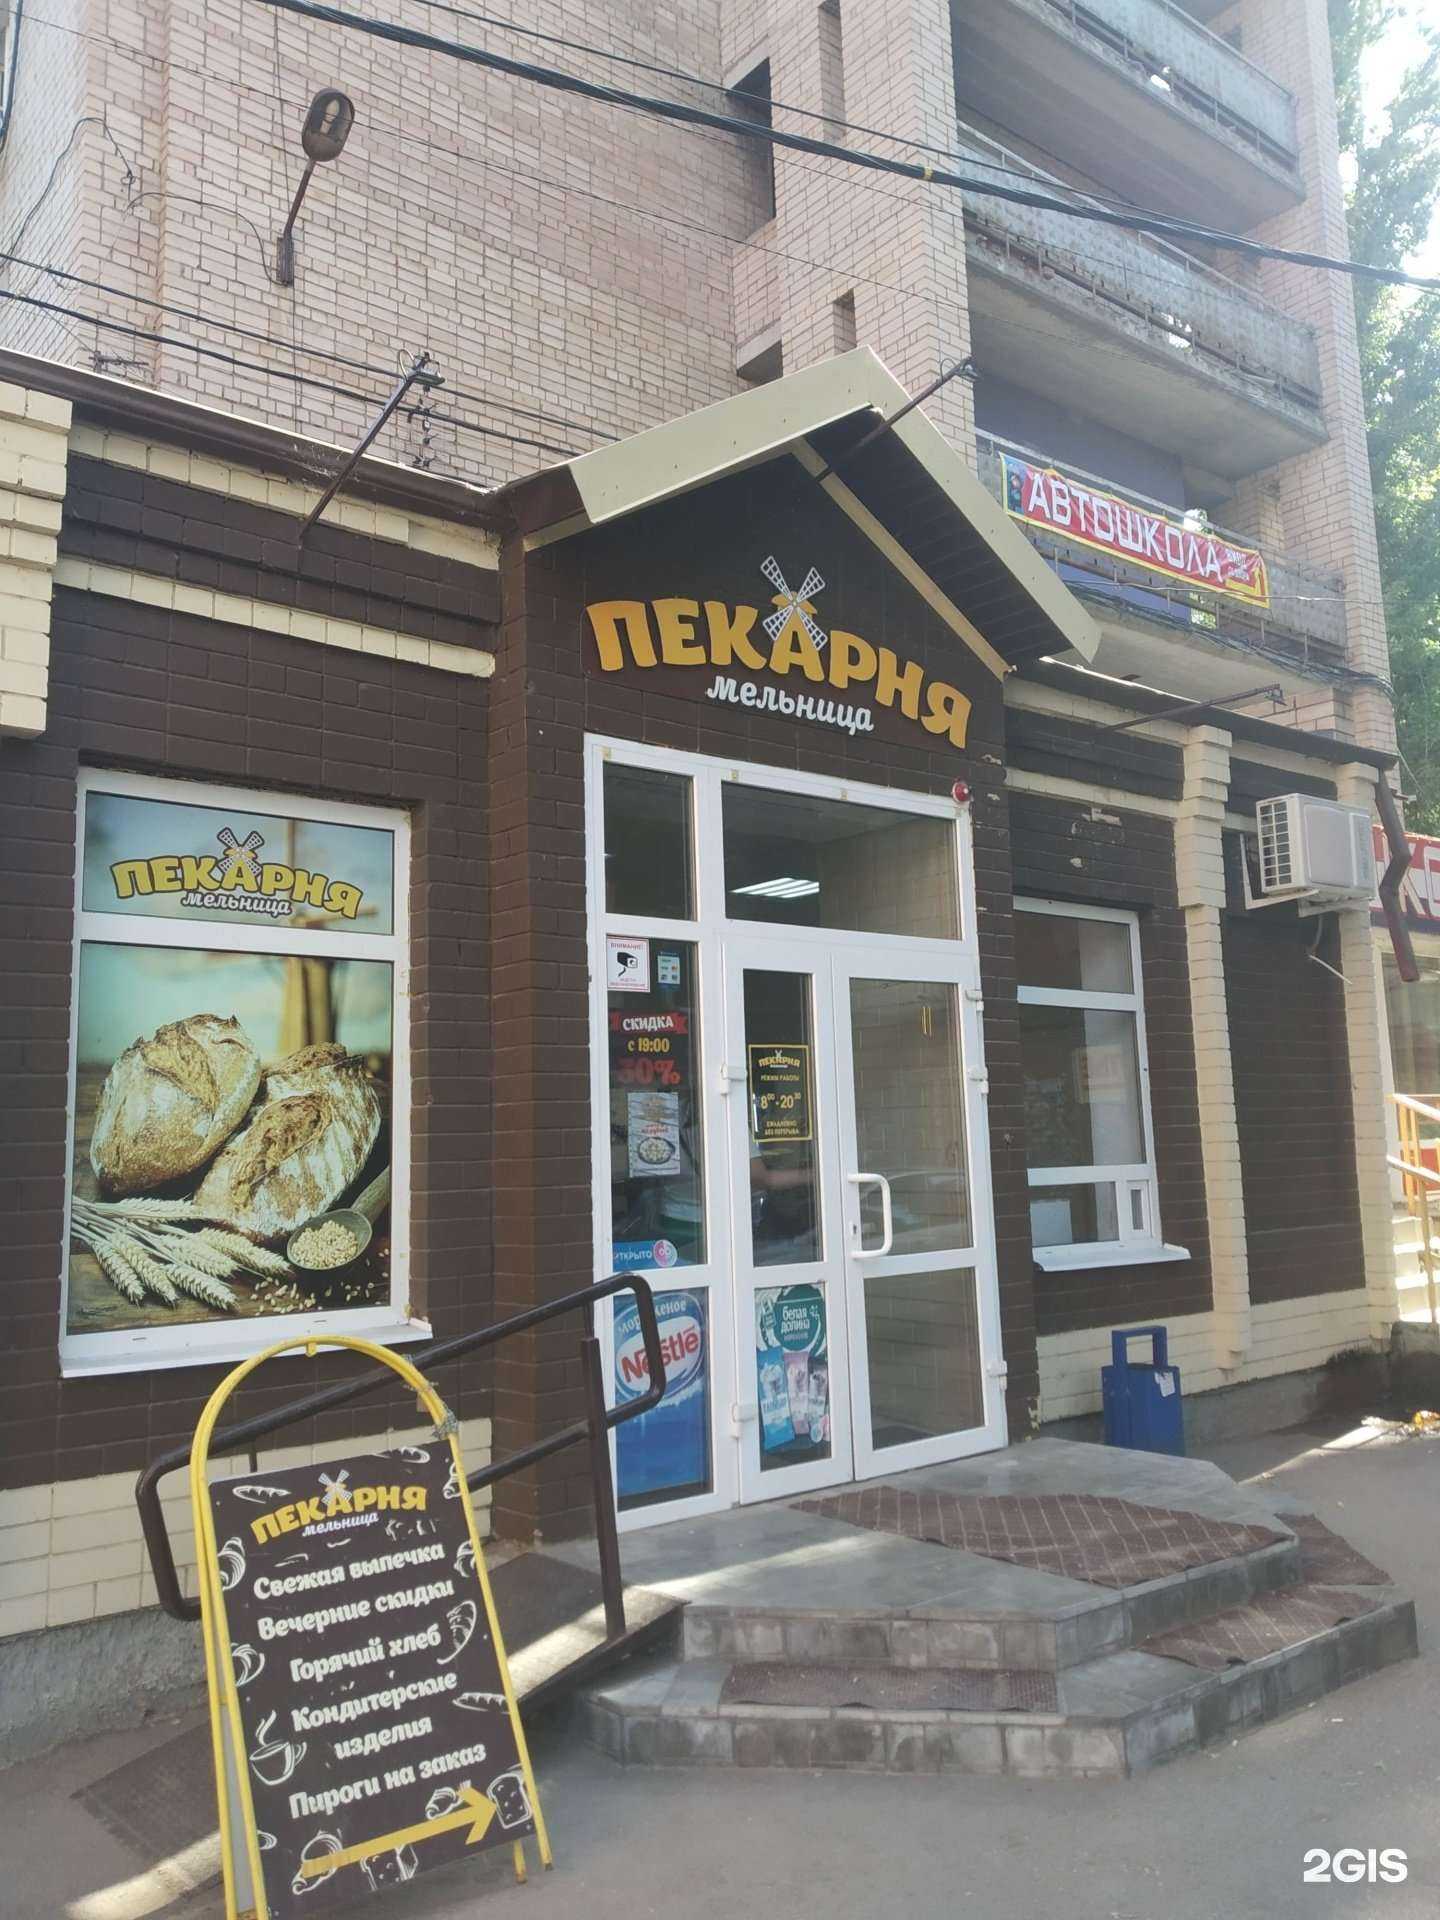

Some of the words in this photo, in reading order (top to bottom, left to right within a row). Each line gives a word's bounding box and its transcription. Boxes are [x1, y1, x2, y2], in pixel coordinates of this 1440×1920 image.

[1028, 473, 1223, 582] АВТОШКОЛА
[586, 591, 972, 749] ПЕКАРНЯ
[706, 675, 875, 736] мельница
[111, 850, 364, 919] ПЕКАРНЯ
[181, 889, 292, 917] мельница
[622, 1015, 675, 1032] СКИДКА
[638, 1038, 670, 1053] 19:00
[251, 1484, 427, 1545] ПЕКАРНЯ
[302, 1510, 379, 1537] мельница
[253, 1562, 346, 1600] Свежая
[349, 1542, 445, 1578] выпечка
[257, 1597, 372, 1640] Вечерние
[375, 1579, 455, 1615] скидки
[289, 1636, 386, 1682] Горячий
[389, 1623, 442, 1657] хлеб
[291, 1671, 458, 1732] Кондитерские
[334, 1716, 433, 1760] изделия
[289, 1776, 381, 1820] Пироги
[384, 1763, 416, 1788] на
[419, 1743, 487, 1779] заказ
